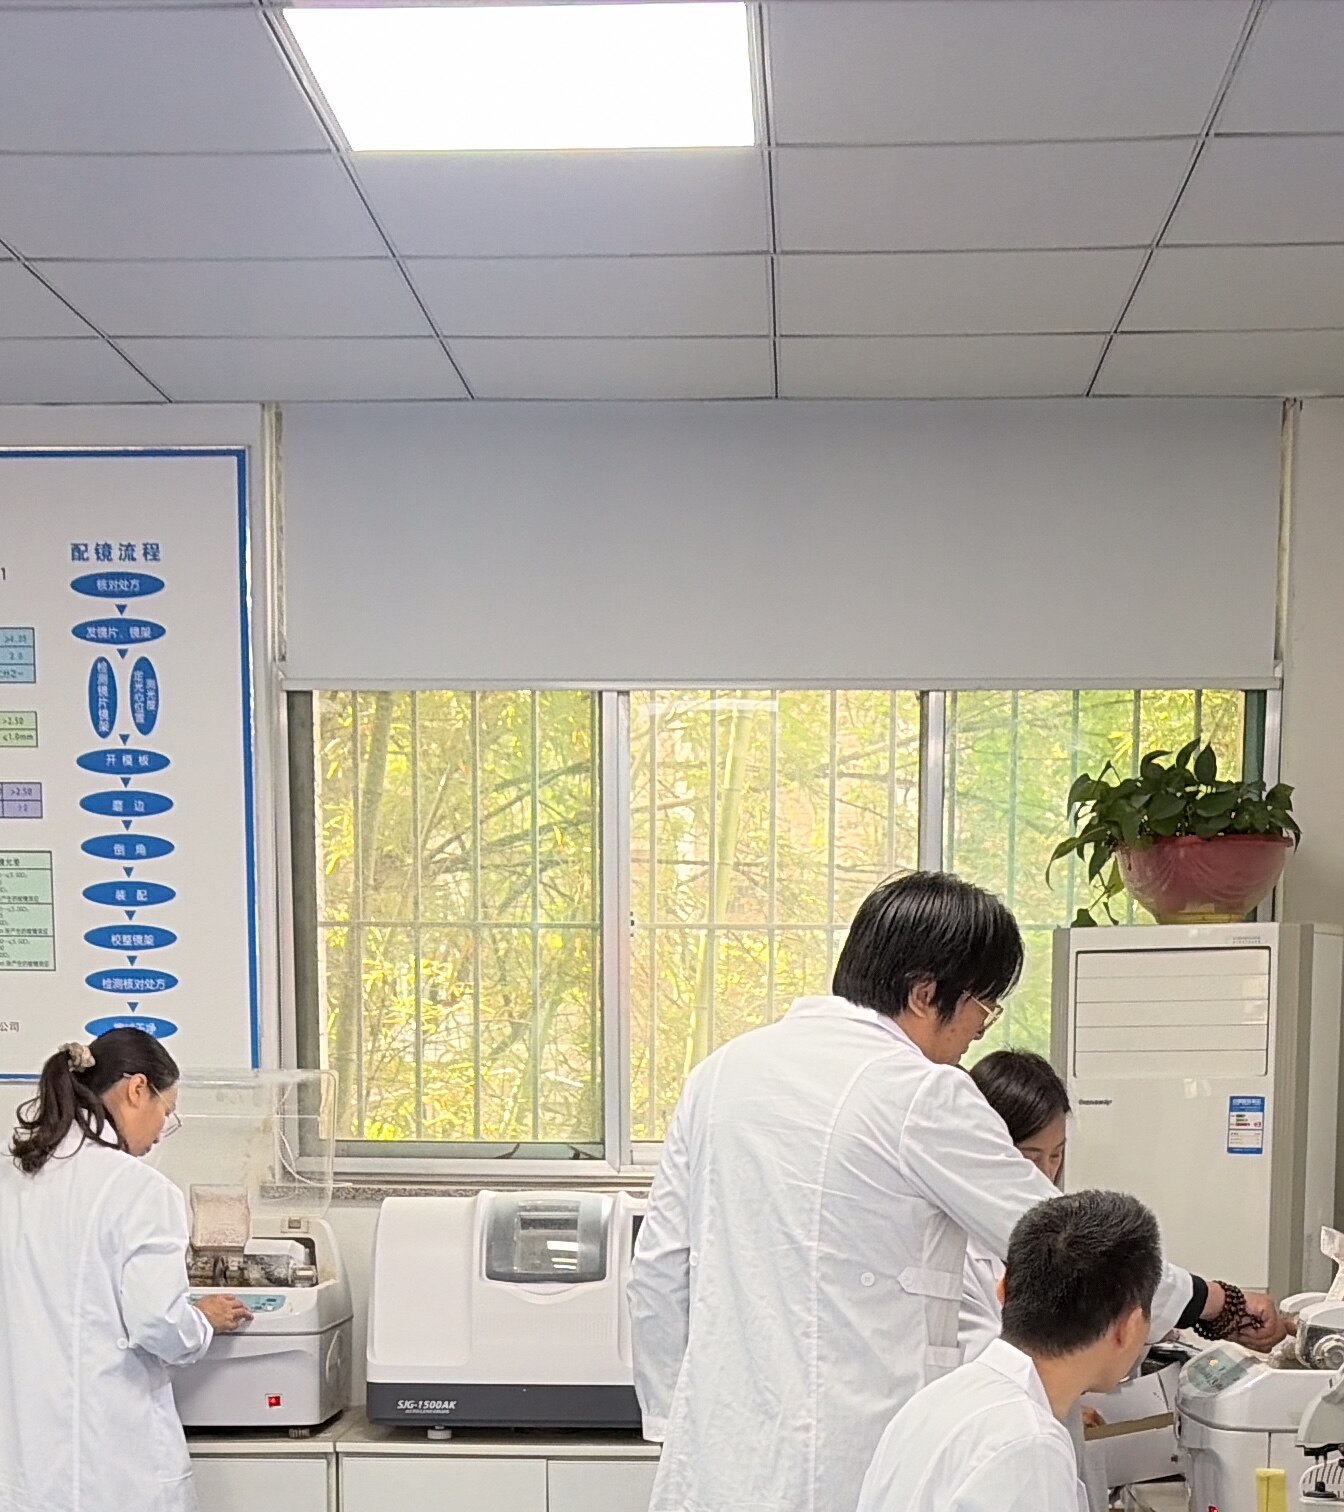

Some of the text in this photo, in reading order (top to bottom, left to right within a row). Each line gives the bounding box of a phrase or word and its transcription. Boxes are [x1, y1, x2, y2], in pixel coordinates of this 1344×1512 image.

[70, 542, 161, 563] 配镜流程
[96, 578, 141, 592] 核对处方
[105, 753, 150, 767] 开模板
[111, 799, 146, 812] 磨边
[113, 843, 147, 856] 倒角
[114, 889, 149, 901] 装配
[111, 933, 154, 947] 校整镜架
[101, 977, 167, 991] 检测核对处方
